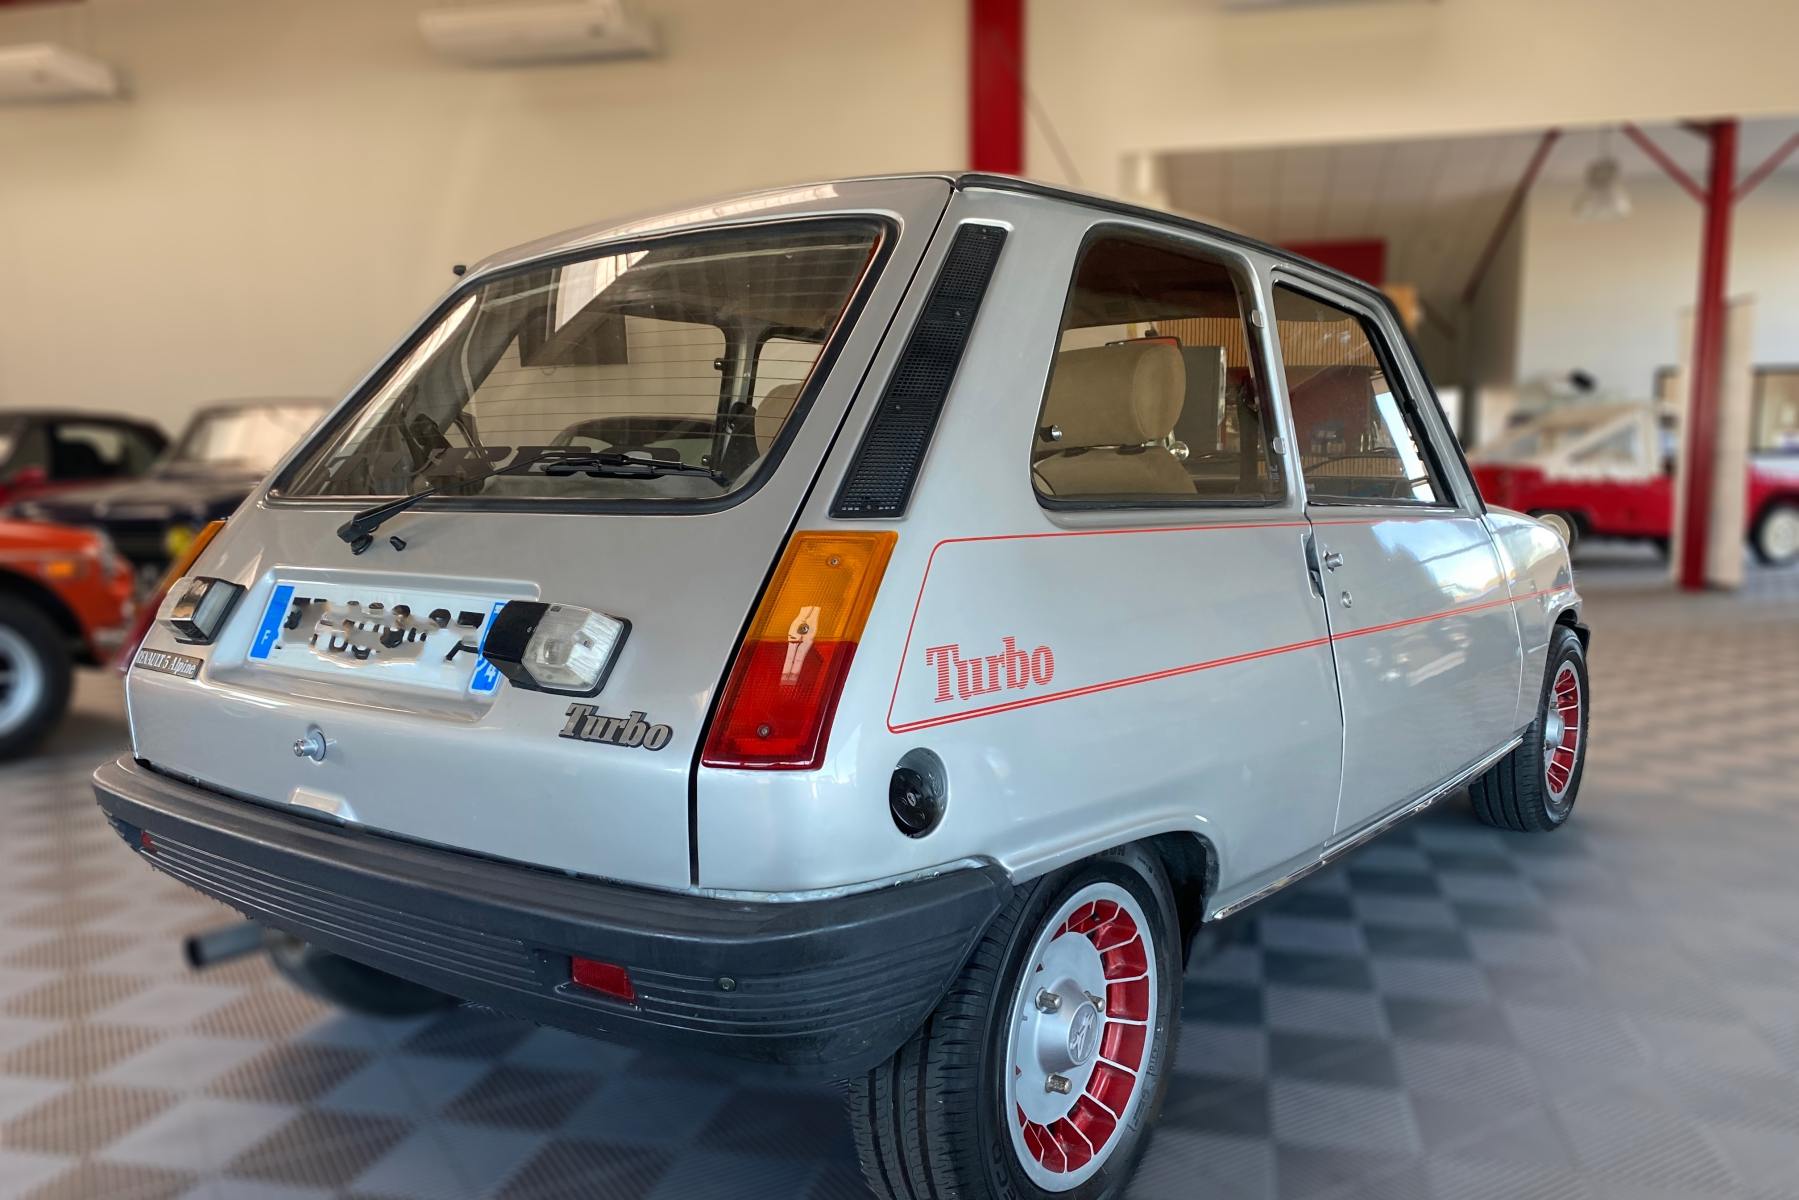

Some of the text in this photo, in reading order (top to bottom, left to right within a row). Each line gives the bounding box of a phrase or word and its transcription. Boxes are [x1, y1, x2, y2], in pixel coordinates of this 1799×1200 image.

[162, 655, 172, 669] 5
[169, 657, 197, 675] Alpine
[926, 635, 1055, 704] Turbo
[558, 702, 674, 752] Turbo
